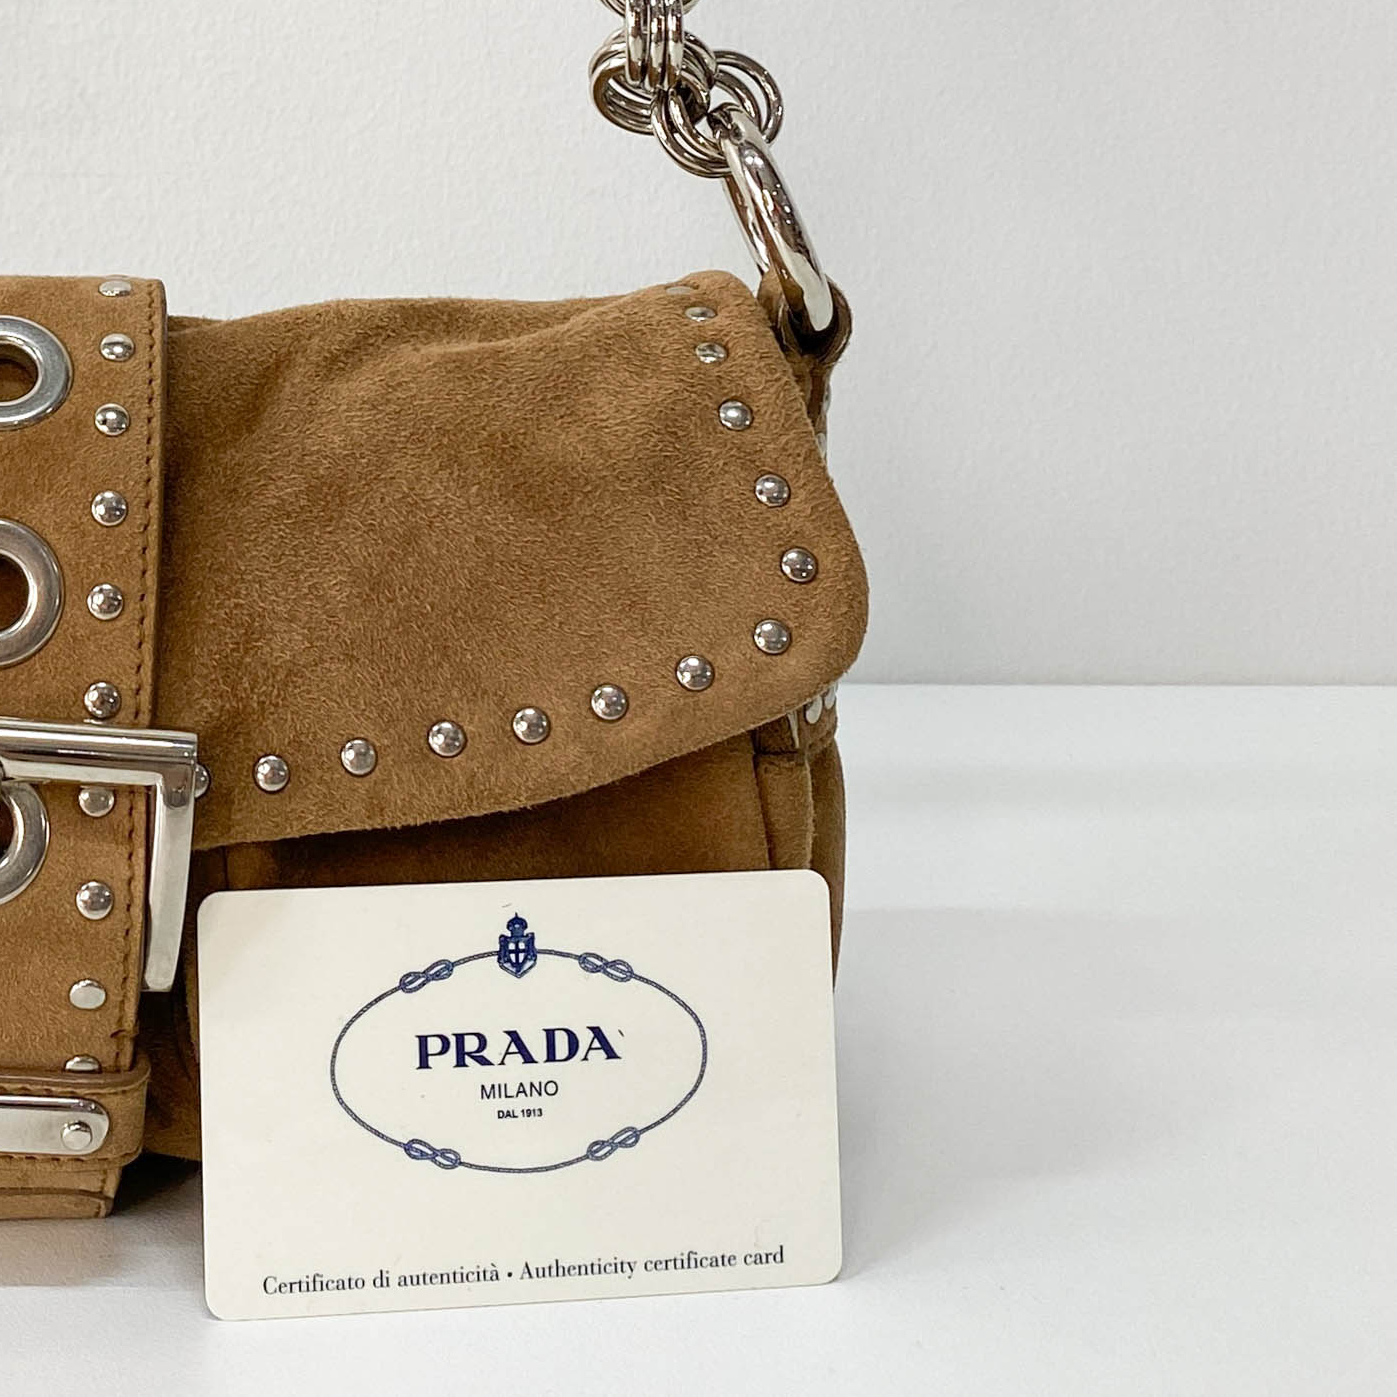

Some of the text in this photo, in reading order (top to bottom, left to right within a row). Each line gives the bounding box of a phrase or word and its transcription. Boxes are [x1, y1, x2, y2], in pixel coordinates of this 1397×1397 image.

[415, 1026, 621, 1070] PRADA
[480, 1080, 559, 1100] MILANO
[497, 1107, 543, 1119] DAL 1913
[262, 1245, 784, 1294] Certificato di autenticità Authenticity certificate card
